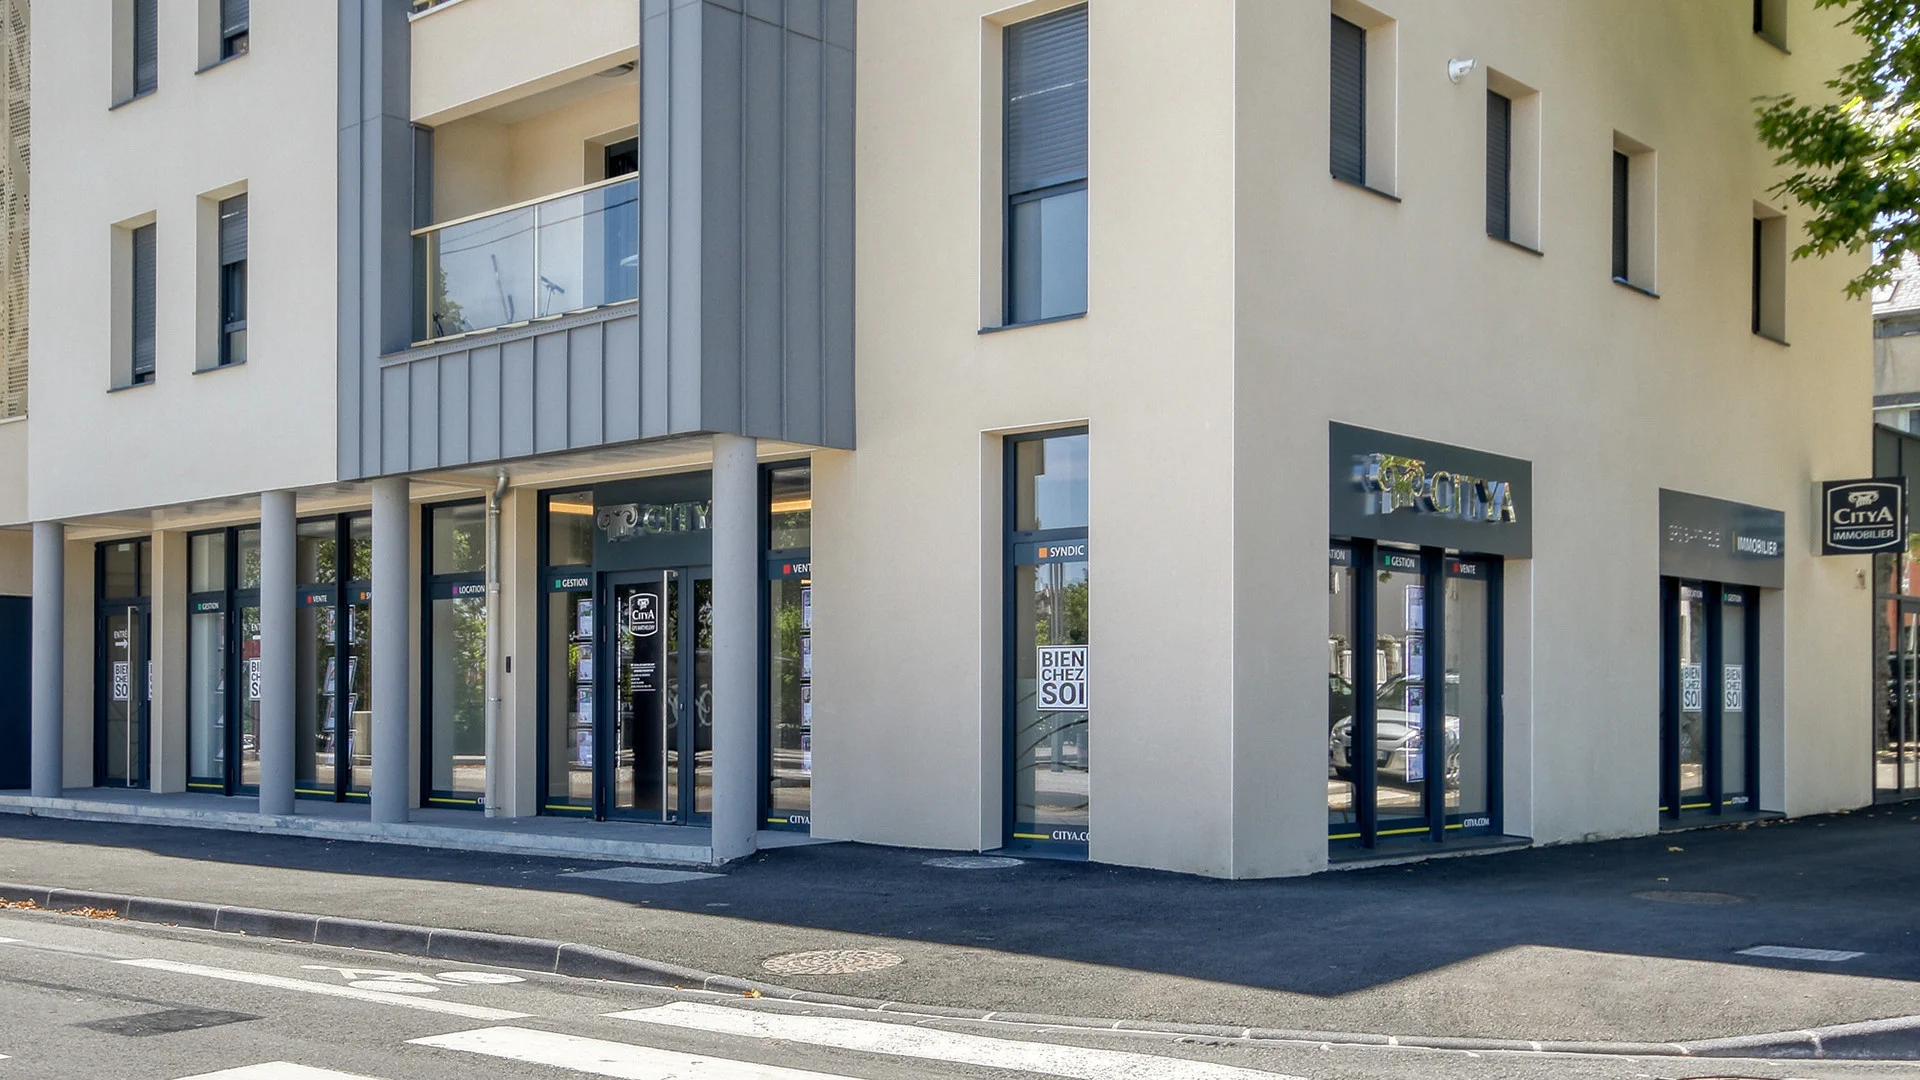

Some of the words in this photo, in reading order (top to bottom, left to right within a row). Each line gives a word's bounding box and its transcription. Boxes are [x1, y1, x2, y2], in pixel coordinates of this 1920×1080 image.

[1430, 471, 1516, 523] CITYA
[643, 500, 711, 534] CITY
[1833, 506, 1893, 524] CITYA
[1833, 529, 1894, 540] IMMOBILIER
[1050, 545, 1085, 557] SYNDIC
[1737, 536, 1778, 555] IMMOBILIER
[793, 563, 811, 573] VENT
[1391, 555, 1415, 568] GESTION
[1460, 564, 1476, 574] VENTE
[562, 578, 588, 587] GESTION
[459, 585, 485, 594] LOCATION
[312, 594, 328, 602] VENTE
[632, 609, 655, 620] CITYA
[1042, 651, 1084, 667] BIEN
[115, 675, 128, 683] CHE
[1042, 668, 1084, 681] CHEZ
[1684, 667, 1700, 679] BIEN
[115, 683, 128, 697] SO
[1042, 682, 1084, 705] SOI
[1684, 690, 1700, 707] SOI
[1727, 691, 1741, 707] SOI
